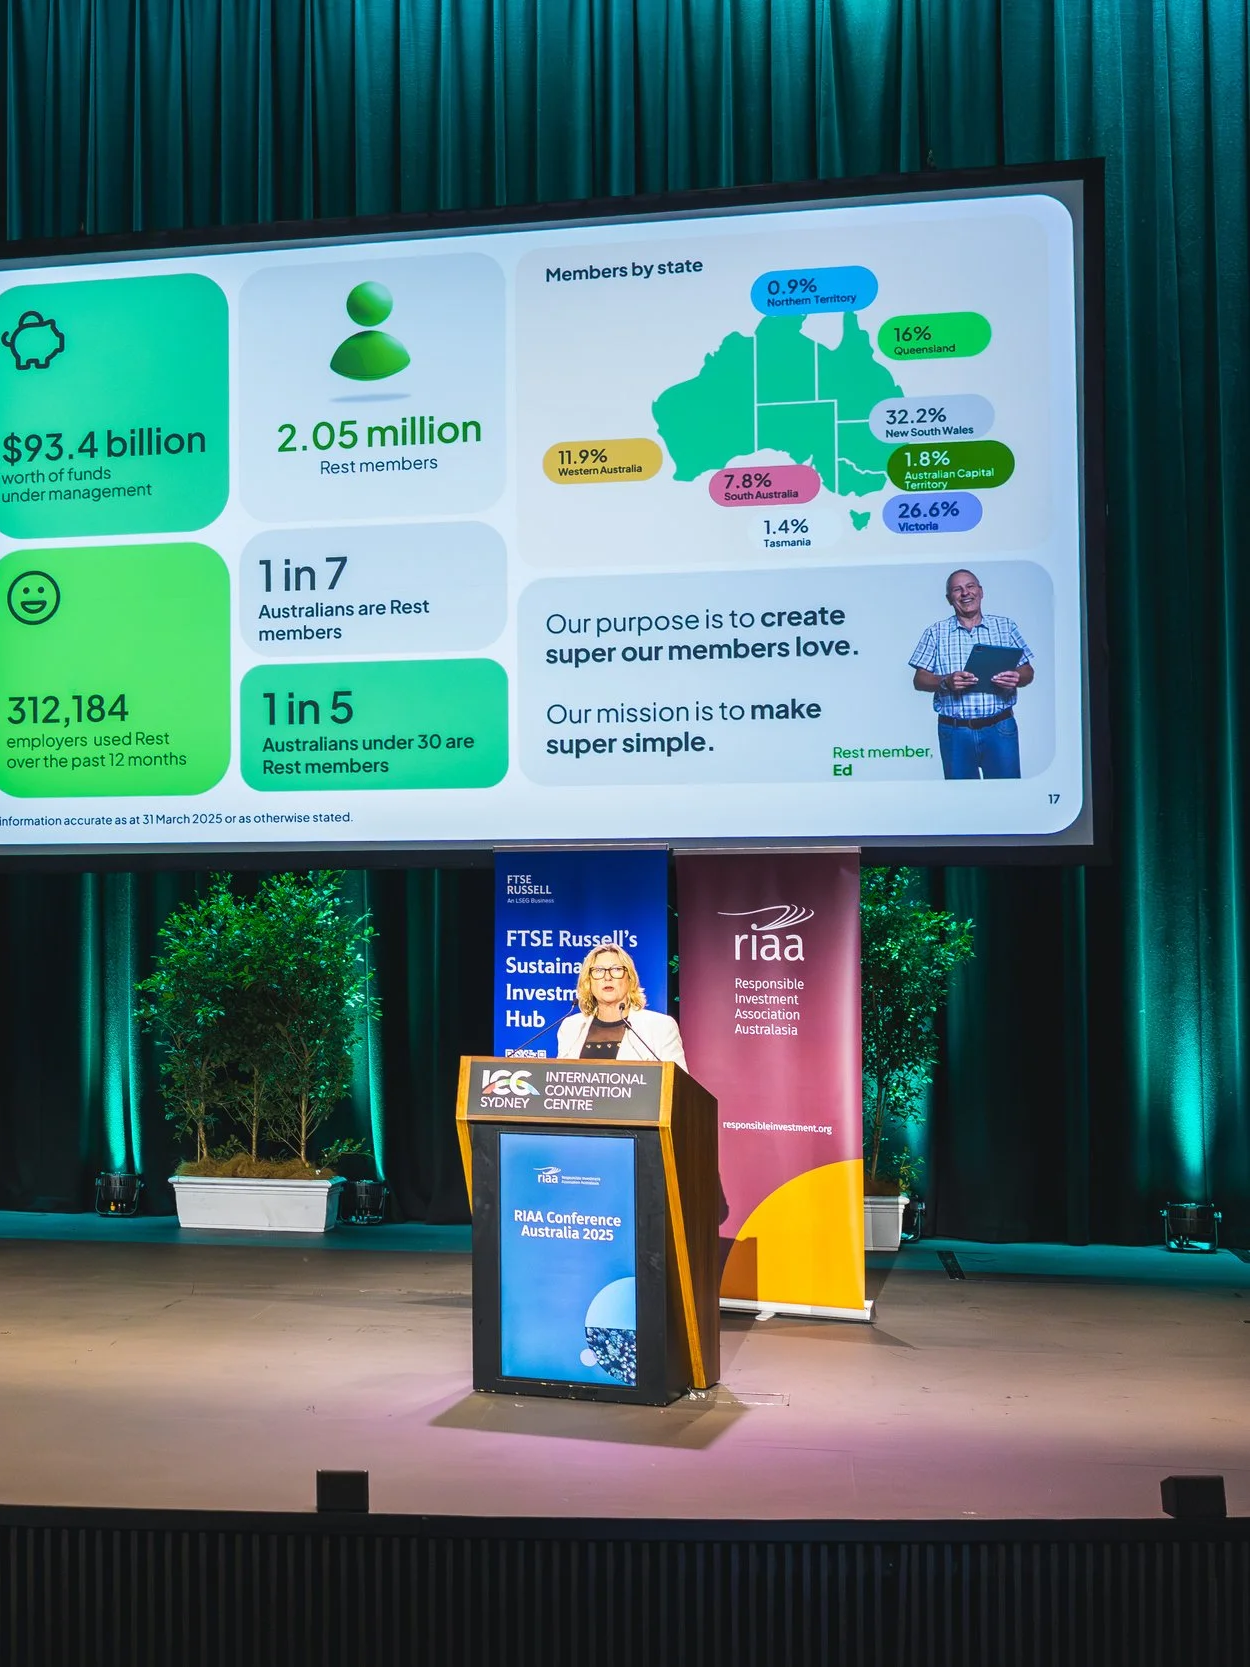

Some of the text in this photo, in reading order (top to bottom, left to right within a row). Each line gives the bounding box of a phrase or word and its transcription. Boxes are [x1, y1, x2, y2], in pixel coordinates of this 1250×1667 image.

[546, 260, 703, 282] Members by state
[768, 278, 817, 295] 0.9%
[767, 295, 856, 307] Northern Territory
[894, 326, 932, 342] 16%
[894, 344, 956, 355] Queensland
[886, 408, 946, 424] 32.2%
[278, 416, 481, 452] 2.05 million
[886, 426, 973, 438] New South Wales
[3, 427, 205, 466] $93.4 billion
[559, 449, 607, 464] 11.9%
[905, 451, 950, 466] 1.8%
[321, 457, 437, 474] Rest members
[558, 465, 642, 476] Western Australia
[2, 466, 111, 484] worth of funds
[725, 473, 772, 489] 7.8%
[905, 468, 994, 480] Australian Capital
[904, 479, 948, 491] Territory
[2, 484, 152, 503] under management
[725, 490, 798, 500] South Australia
[899, 501, 959, 518] 26.6%
[764, 519, 808, 534] 1.4%
[898, 522, 938, 531] Victoria
[764, 538, 811, 547] Tasmania
[259, 556, 347, 592] 1 in 7
[259, 600, 429, 619] Australians are Rest
[547, 607, 845, 637] Our purpose is to create
[259, 625, 342, 641] members
[546, 636, 858, 668] super our members love.
[8, 694, 128, 728] 312,184
[263, 691, 353, 725] 1 in 5
[547, 699, 821, 724] Our mission is to make
[7, 732, 169, 751] employers used Rest
[262, 734, 474, 752] Australians under 30 are
[547, 732, 713, 758] super simple.
[834, 746, 932, 758] Rest member,
[7, 752, 186, 770] over the past 12 months
[263, 758, 388, 774] Rest members
[834, 764, 852, 776] Ed
[1049, 794, 1060, 804] 17
[0, 816, 61, 826] information
[64, 817, 112, 825] accurate
[115, 817, 127, 825] as
[130, 816, 140, 824] at
[143, 815, 153, 824] 31
[156, 814, 190, 824] March
[193, 814, 222, 824] 2025
[254, 813, 310, 823] otherwise
[313, 812, 353, 822] stated.
[508, 875, 531, 884] FTSE
[507, 885, 551, 894] RUSSELL
[507, 930, 553, 946] FTSE
[735, 924, 804, 962] riaa
[736, 978, 804, 991] Responsible
[736, 993, 798, 1004] Investment
[506, 1010, 545, 1027] Hub
[735, 1008, 799, 1020] Association
[735, 1024, 798, 1035] Australasia
[546, 1072, 646, 1084] INTERNATIONAL
[545, 1085, 631, 1098] CONVENTION
[480, 1097, 529, 1108] SYDNEY
[544, 1099, 593, 1110] CENTRE
[723, 1121, 832, 1135] responsibleinvestment.org
[515, 1210, 622, 1227] RIAA Conference
[521, 1224, 614, 1242] Australia 2025
